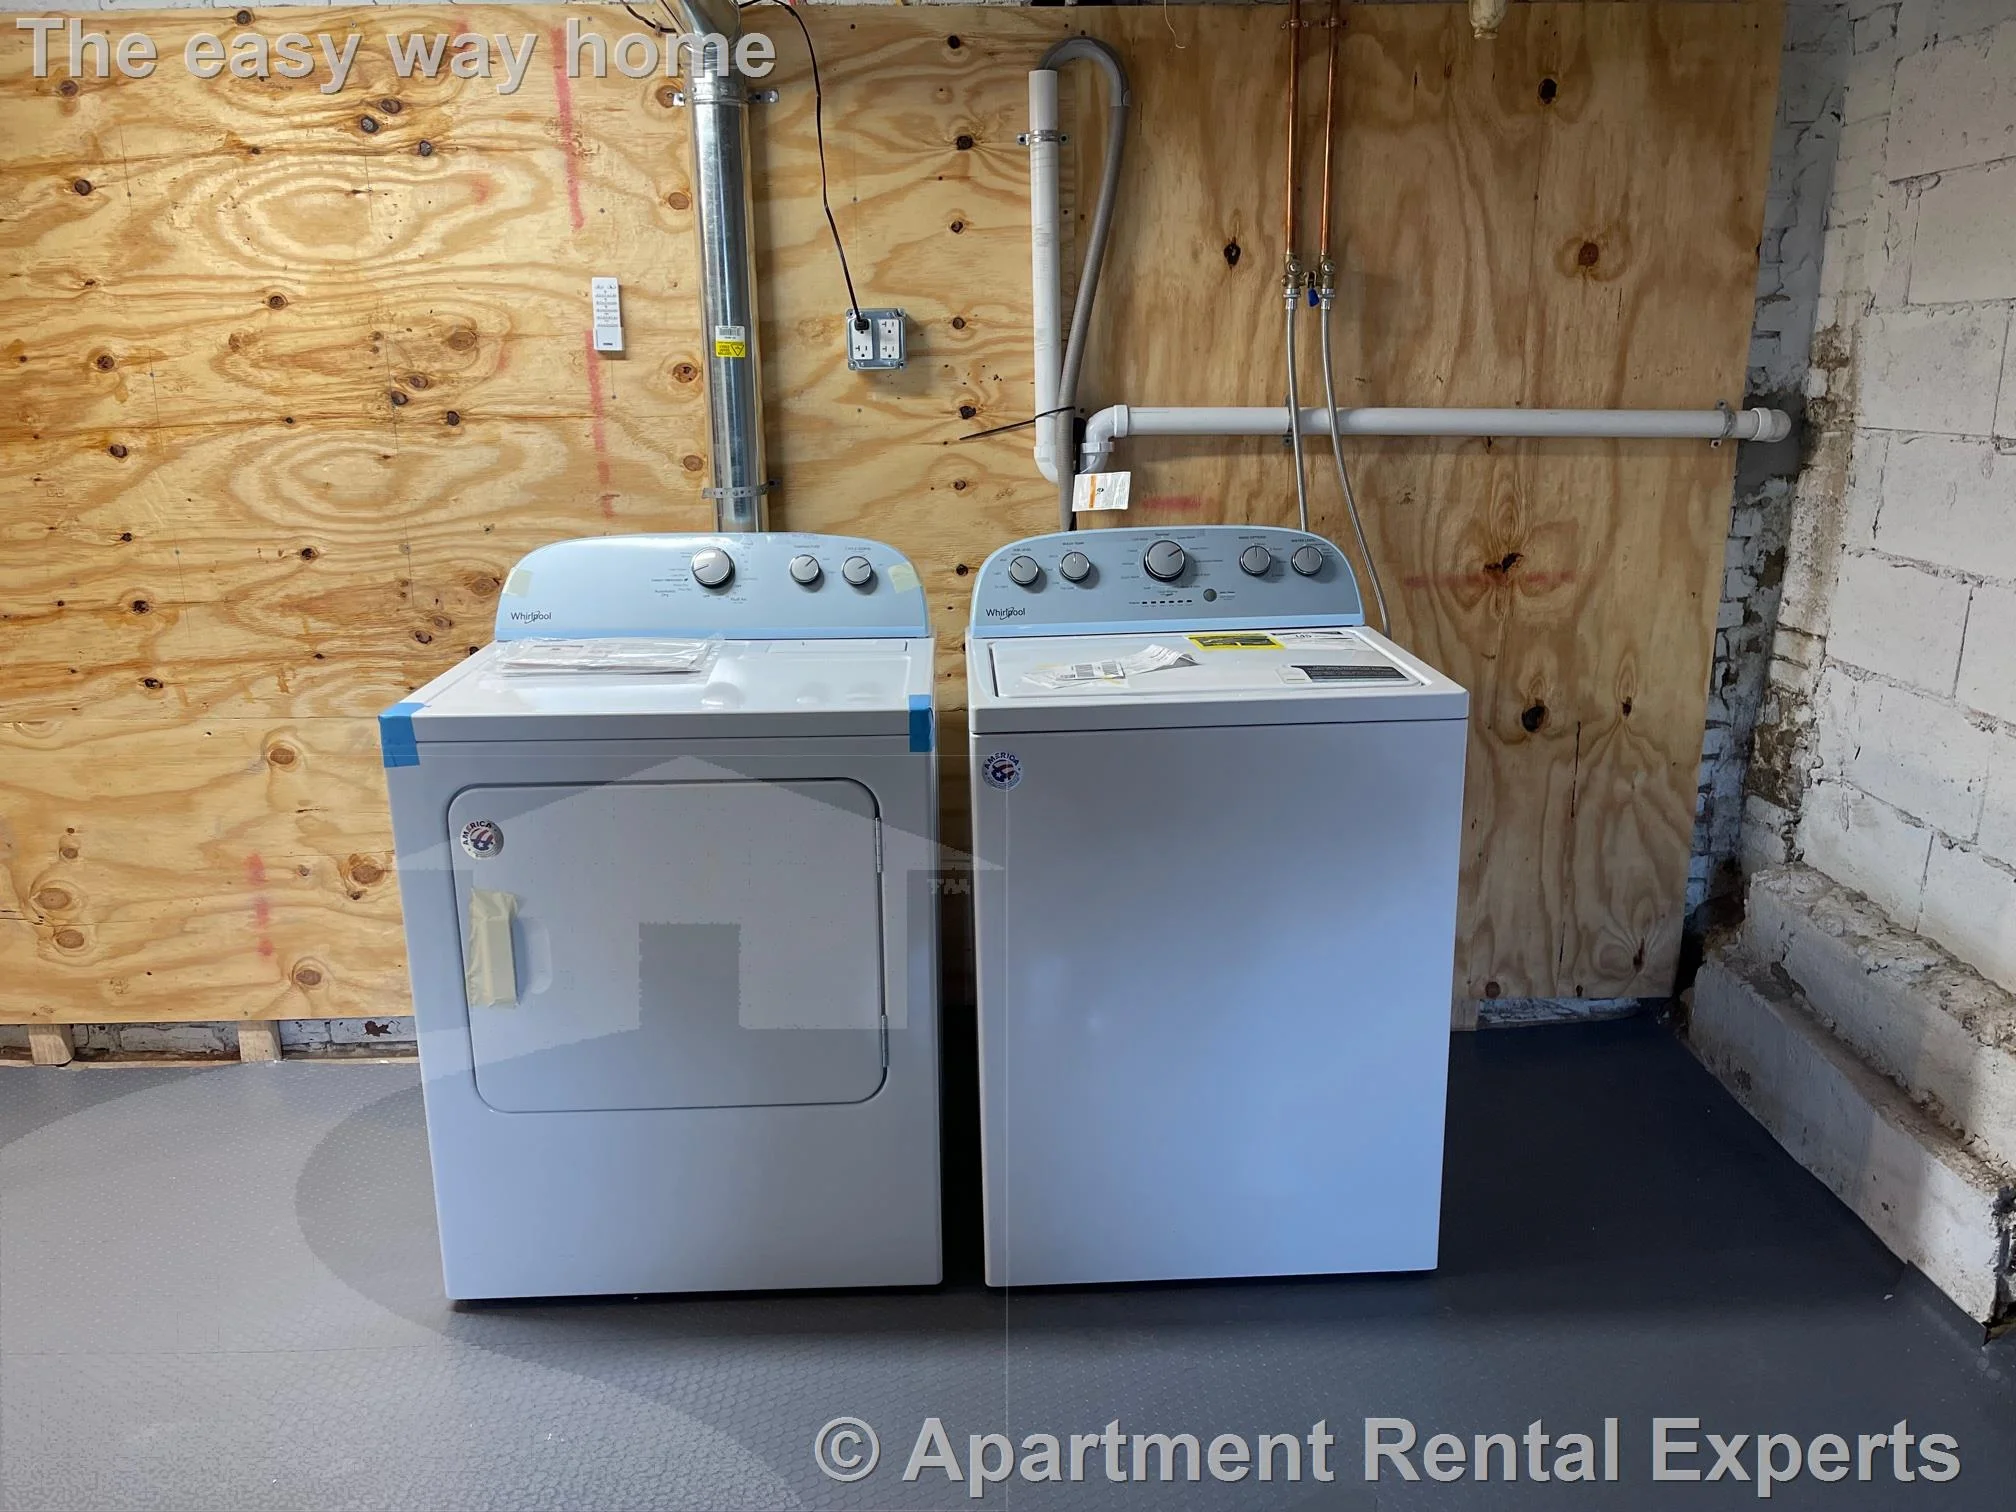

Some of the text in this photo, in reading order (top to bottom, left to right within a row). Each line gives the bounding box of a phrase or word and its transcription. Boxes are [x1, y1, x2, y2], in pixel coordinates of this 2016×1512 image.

[510, 610, 552, 624] Whirlpool
[985, 607, 1026, 620] Whirlpool
[984, 752, 1020, 770] AMERICA
[462, 820, 492, 846] AMERICA
